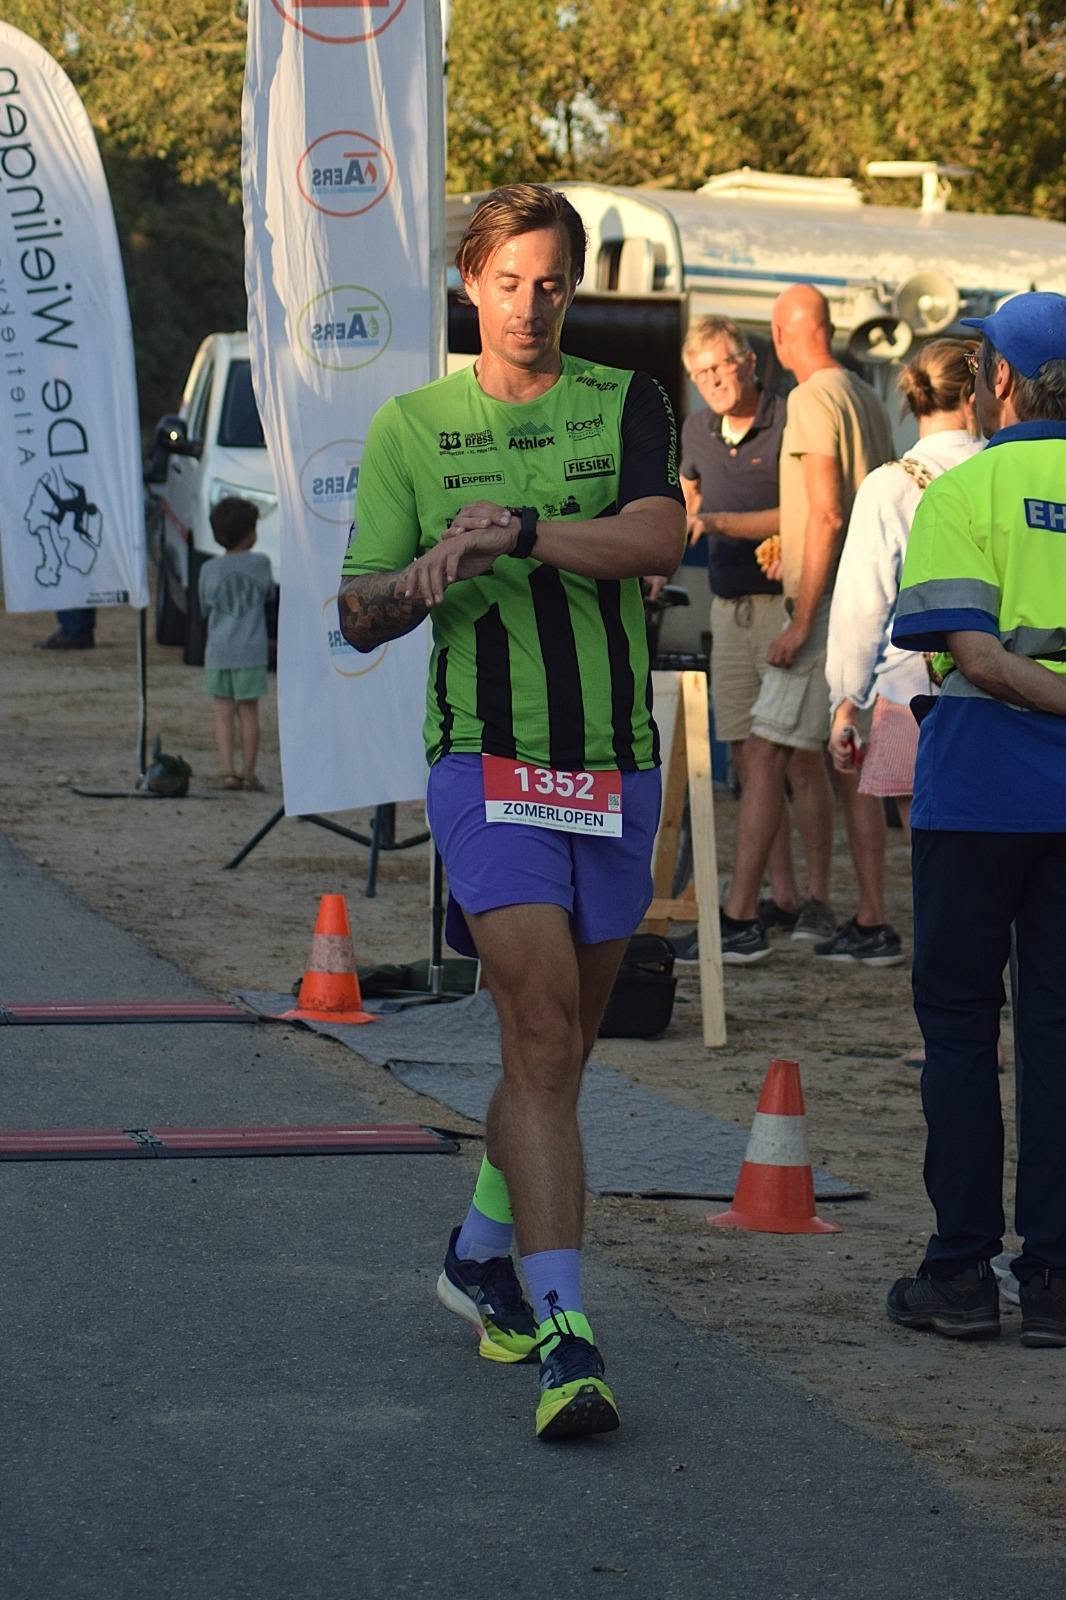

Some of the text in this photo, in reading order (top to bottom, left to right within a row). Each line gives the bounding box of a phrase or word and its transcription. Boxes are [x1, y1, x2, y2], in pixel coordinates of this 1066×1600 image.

[465, 434, 494, 448] press
[508, 436, 555, 450] Athlex
[568, 458, 611, 474] FIESIEK
[445, 474, 503, 489] IT EXPERTS
[514, 766, 595, 800] 1352
[503, 802, 604, 827] ZOMERLOPEN
